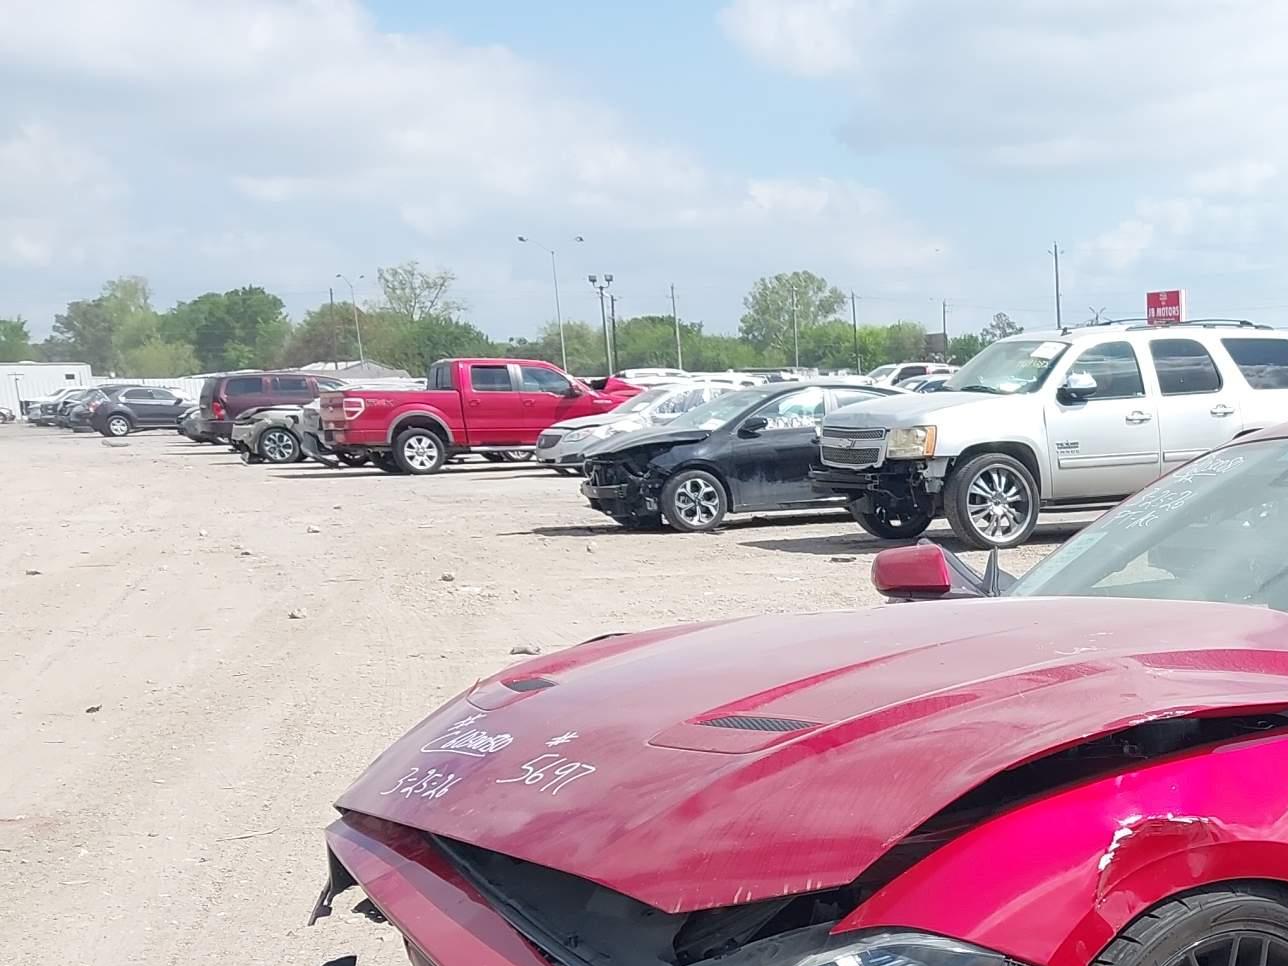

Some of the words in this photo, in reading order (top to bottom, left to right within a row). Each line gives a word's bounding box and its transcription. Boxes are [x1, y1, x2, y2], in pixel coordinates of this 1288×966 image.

[1156, 305, 1180, 317] MOTORS
[380, 767, 463, 800] 3-25-26
[496, 753, 597, 796] 5697
